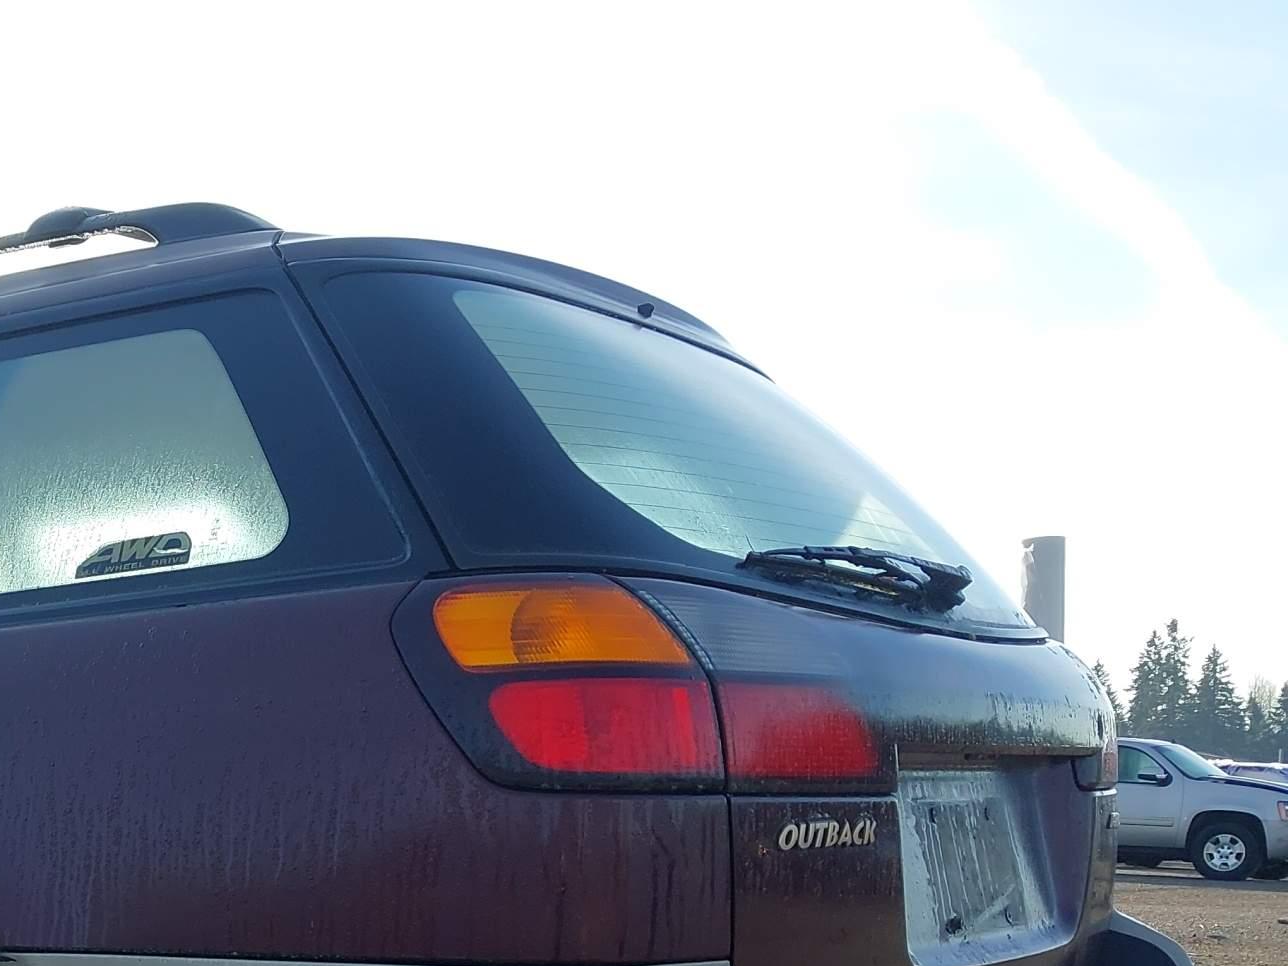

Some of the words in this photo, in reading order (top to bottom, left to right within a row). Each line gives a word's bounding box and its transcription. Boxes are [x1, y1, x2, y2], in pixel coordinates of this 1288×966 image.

[80, 532, 191, 567] AWD
[104, 562, 145, 574] WHEEL
[778, 818, 877, 850] OUTBACK
